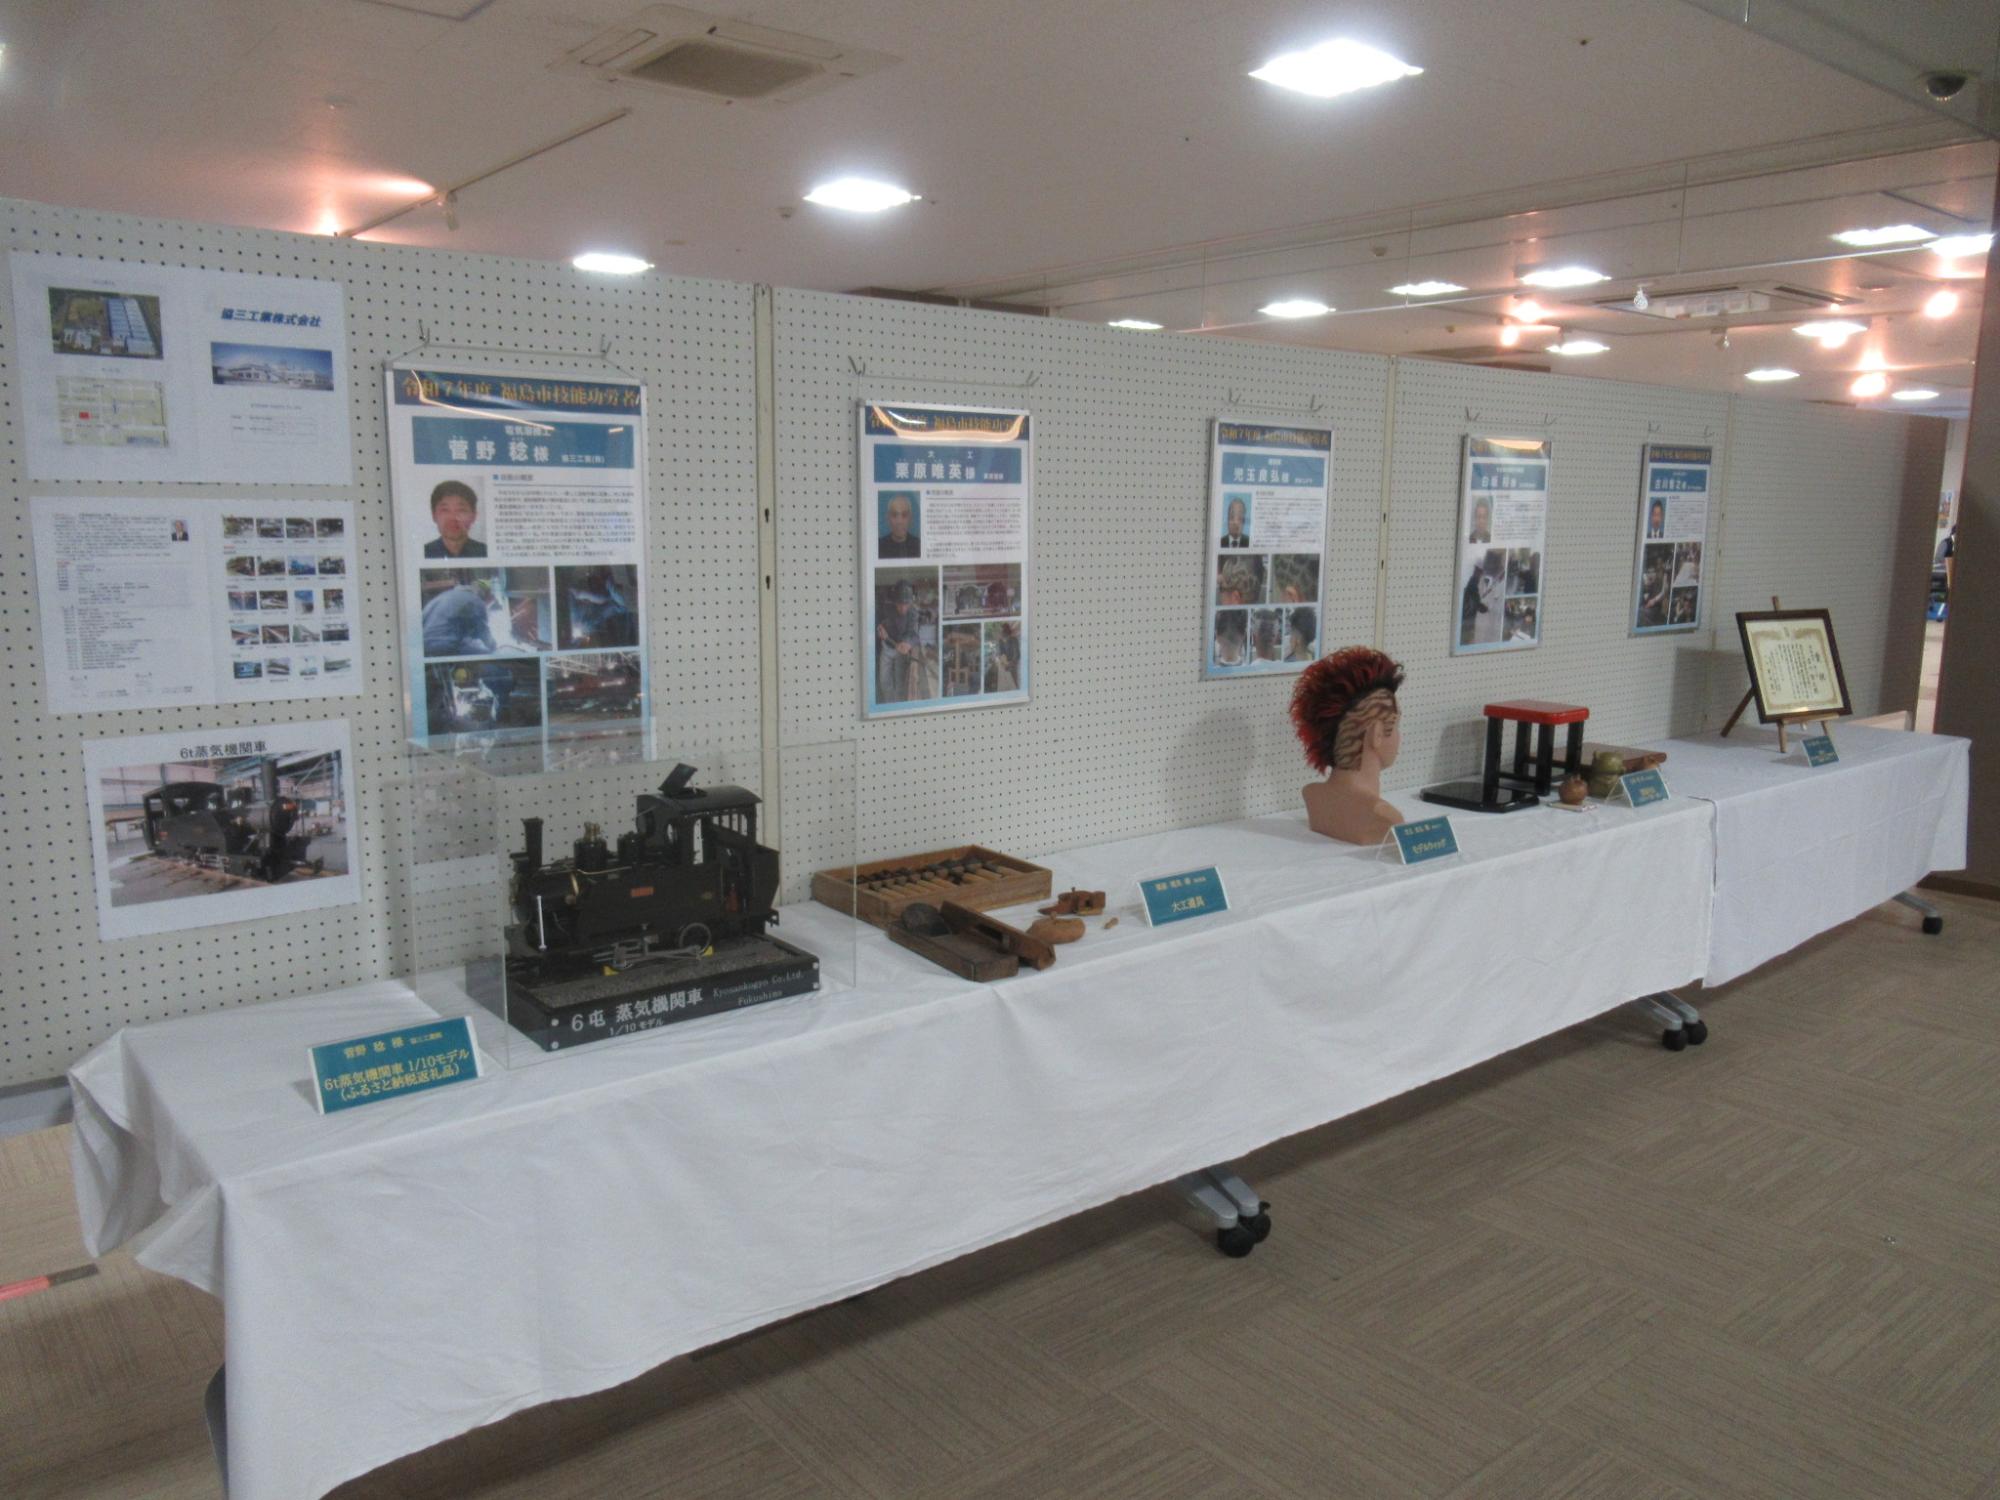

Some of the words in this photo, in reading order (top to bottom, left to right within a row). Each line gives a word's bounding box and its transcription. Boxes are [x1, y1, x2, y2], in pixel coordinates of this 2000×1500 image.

[179, 740, 269, 760] 6t蒸気機関車
